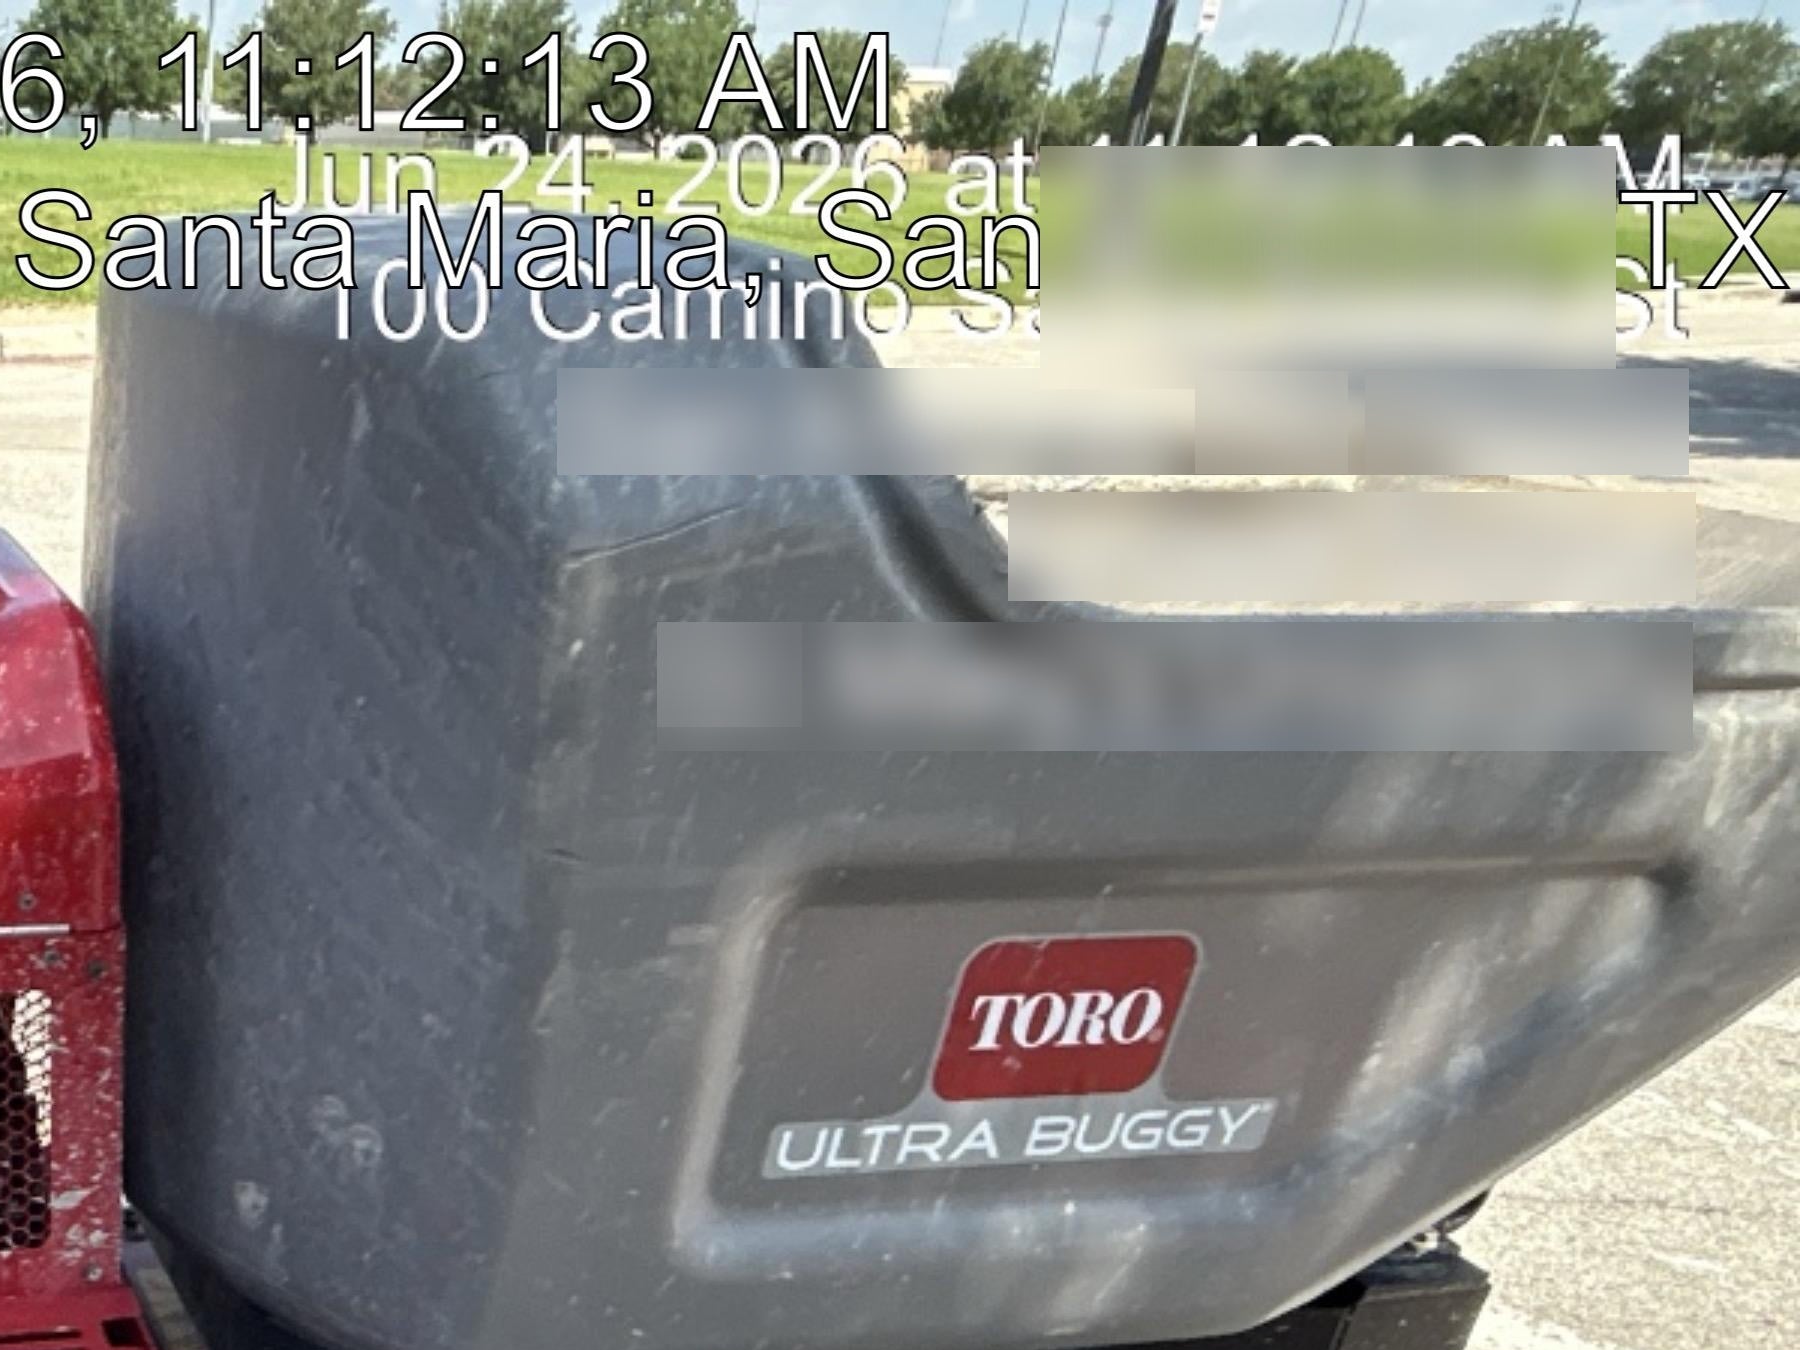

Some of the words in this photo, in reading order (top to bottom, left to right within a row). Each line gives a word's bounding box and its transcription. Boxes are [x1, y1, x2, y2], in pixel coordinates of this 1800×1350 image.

[967, 987, 1164, 1051] TORO
[775, 1118, 1000, 1171] ULTRA
[1024, 1102, 1264, 1158] BUGGY
